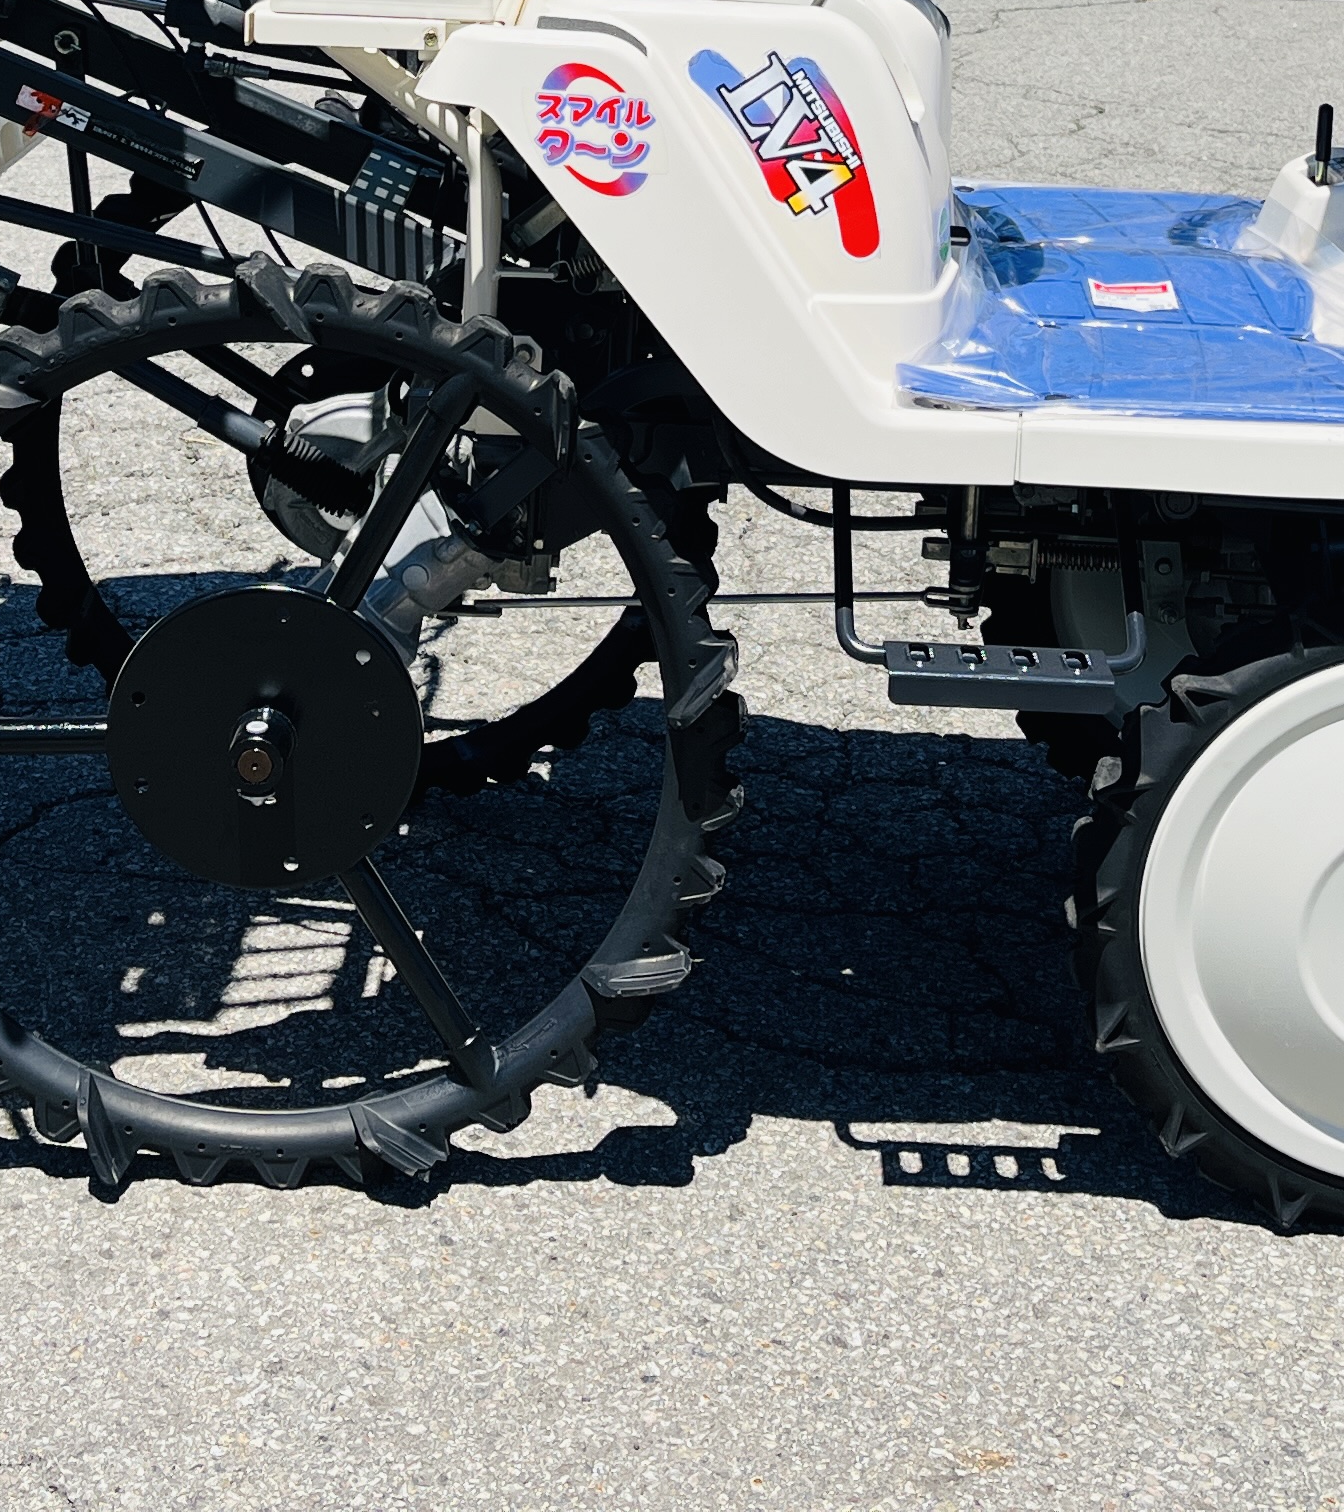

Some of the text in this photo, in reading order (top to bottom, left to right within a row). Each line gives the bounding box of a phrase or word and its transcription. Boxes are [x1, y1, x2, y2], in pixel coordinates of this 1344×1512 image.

[536, 93, 654, 128] スマイル
[717, 51, 855, 216] LV4
[791, 68, 862, 170] MITSUBISHI
[536, 128, 649, 168] ターン
